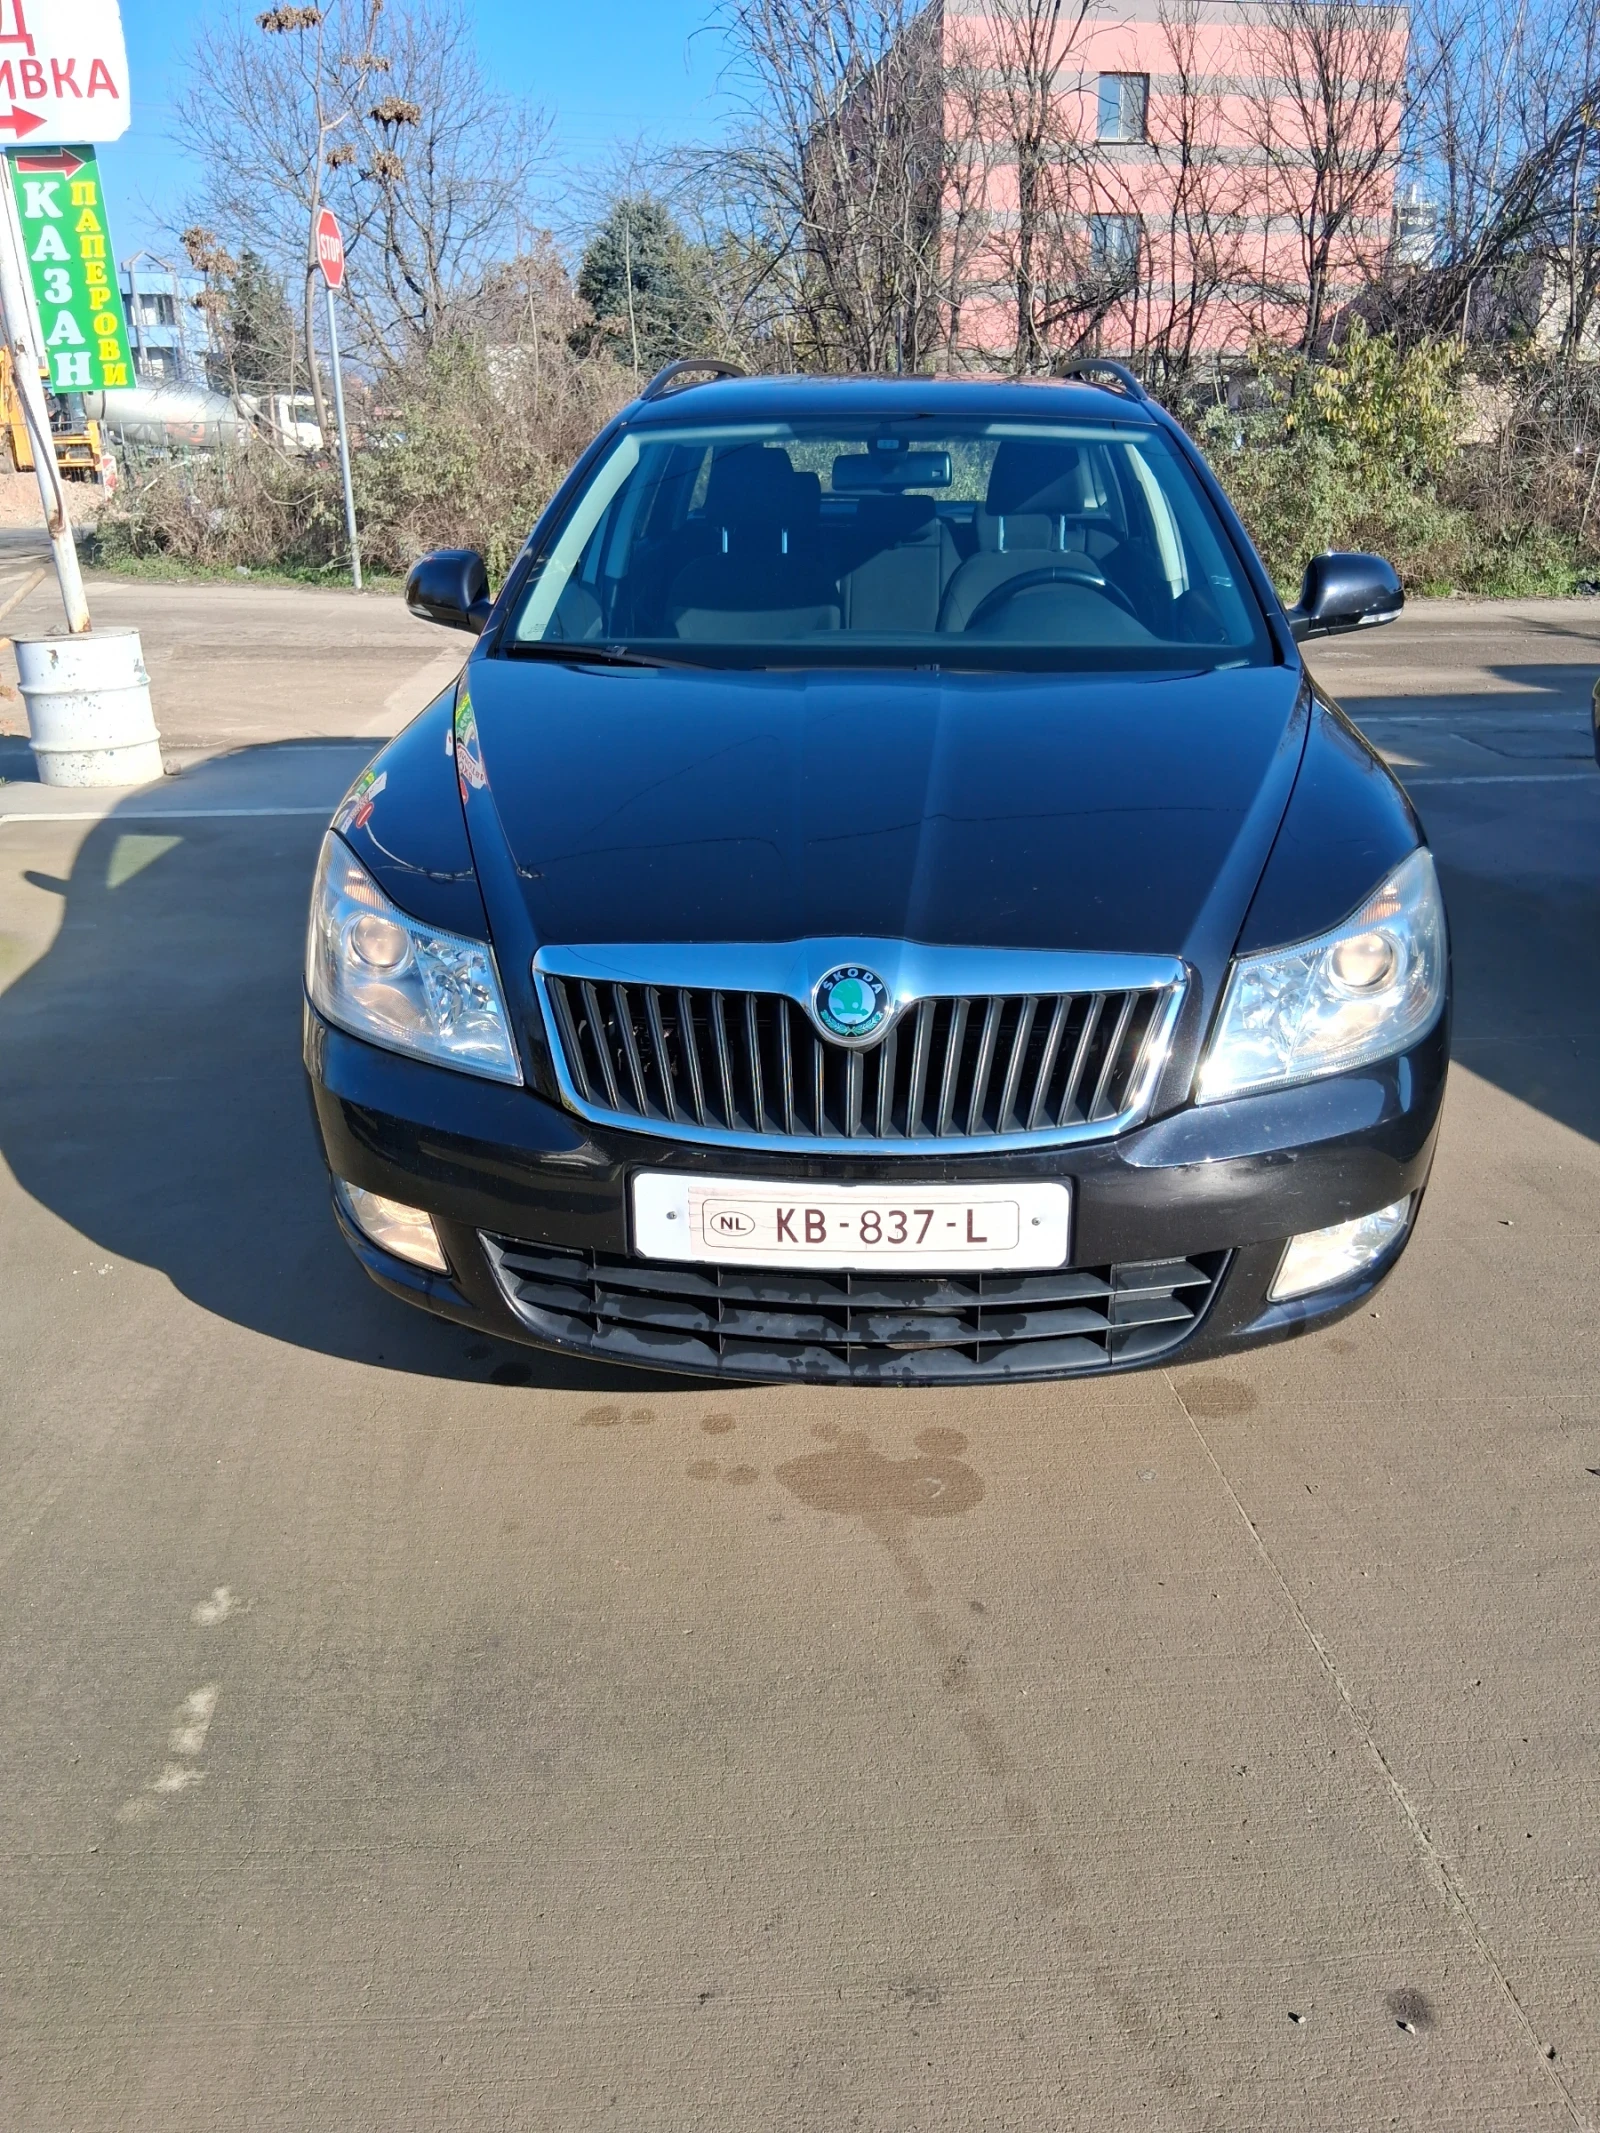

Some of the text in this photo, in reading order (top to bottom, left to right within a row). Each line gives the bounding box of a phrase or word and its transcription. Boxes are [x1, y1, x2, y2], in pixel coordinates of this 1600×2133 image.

[22, 181, 93, 387] КАЗАН
[70, 181, 128, 387] ПАПЕРОВИ
[320, 233, 341, 263] STOP
[720, 1208, 988, 1245] NL KB-837-L
